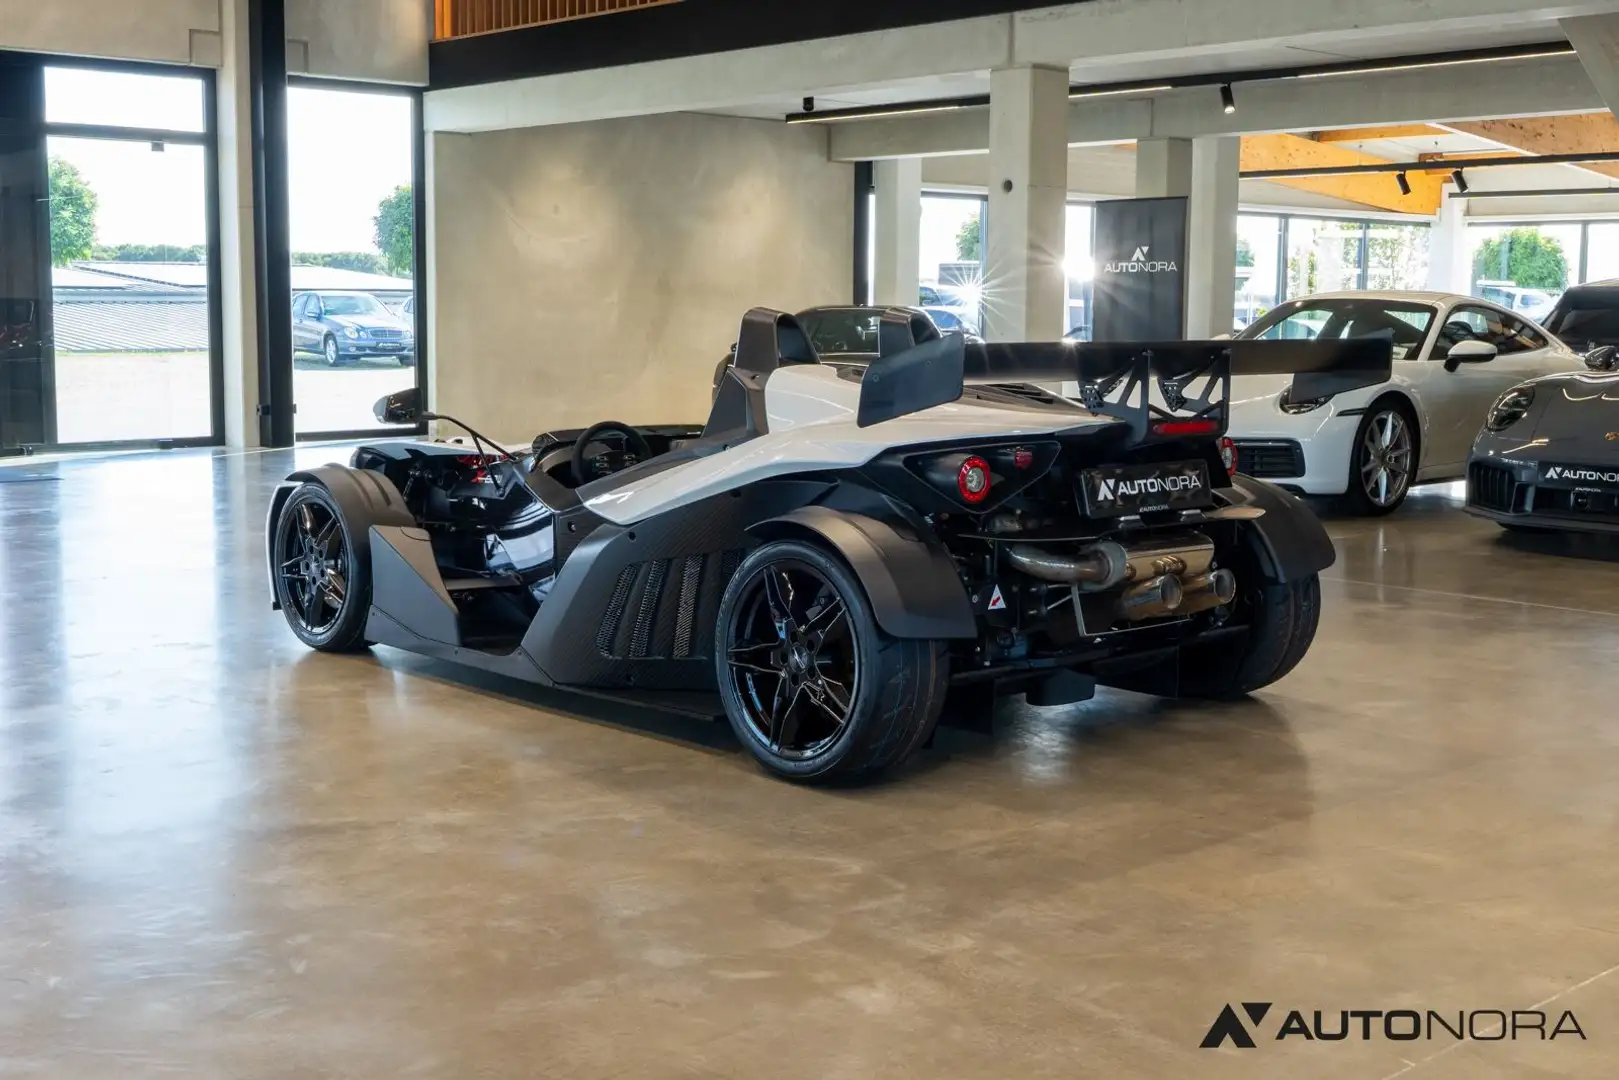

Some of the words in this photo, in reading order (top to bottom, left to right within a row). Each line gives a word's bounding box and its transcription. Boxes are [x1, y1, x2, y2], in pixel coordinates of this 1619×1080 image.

[1104, 261, 1178, 273] AUTONORA
[1562, 469, 1619, 483] AUTONO
[1118, 475, 1202, 496] AUTONORA
